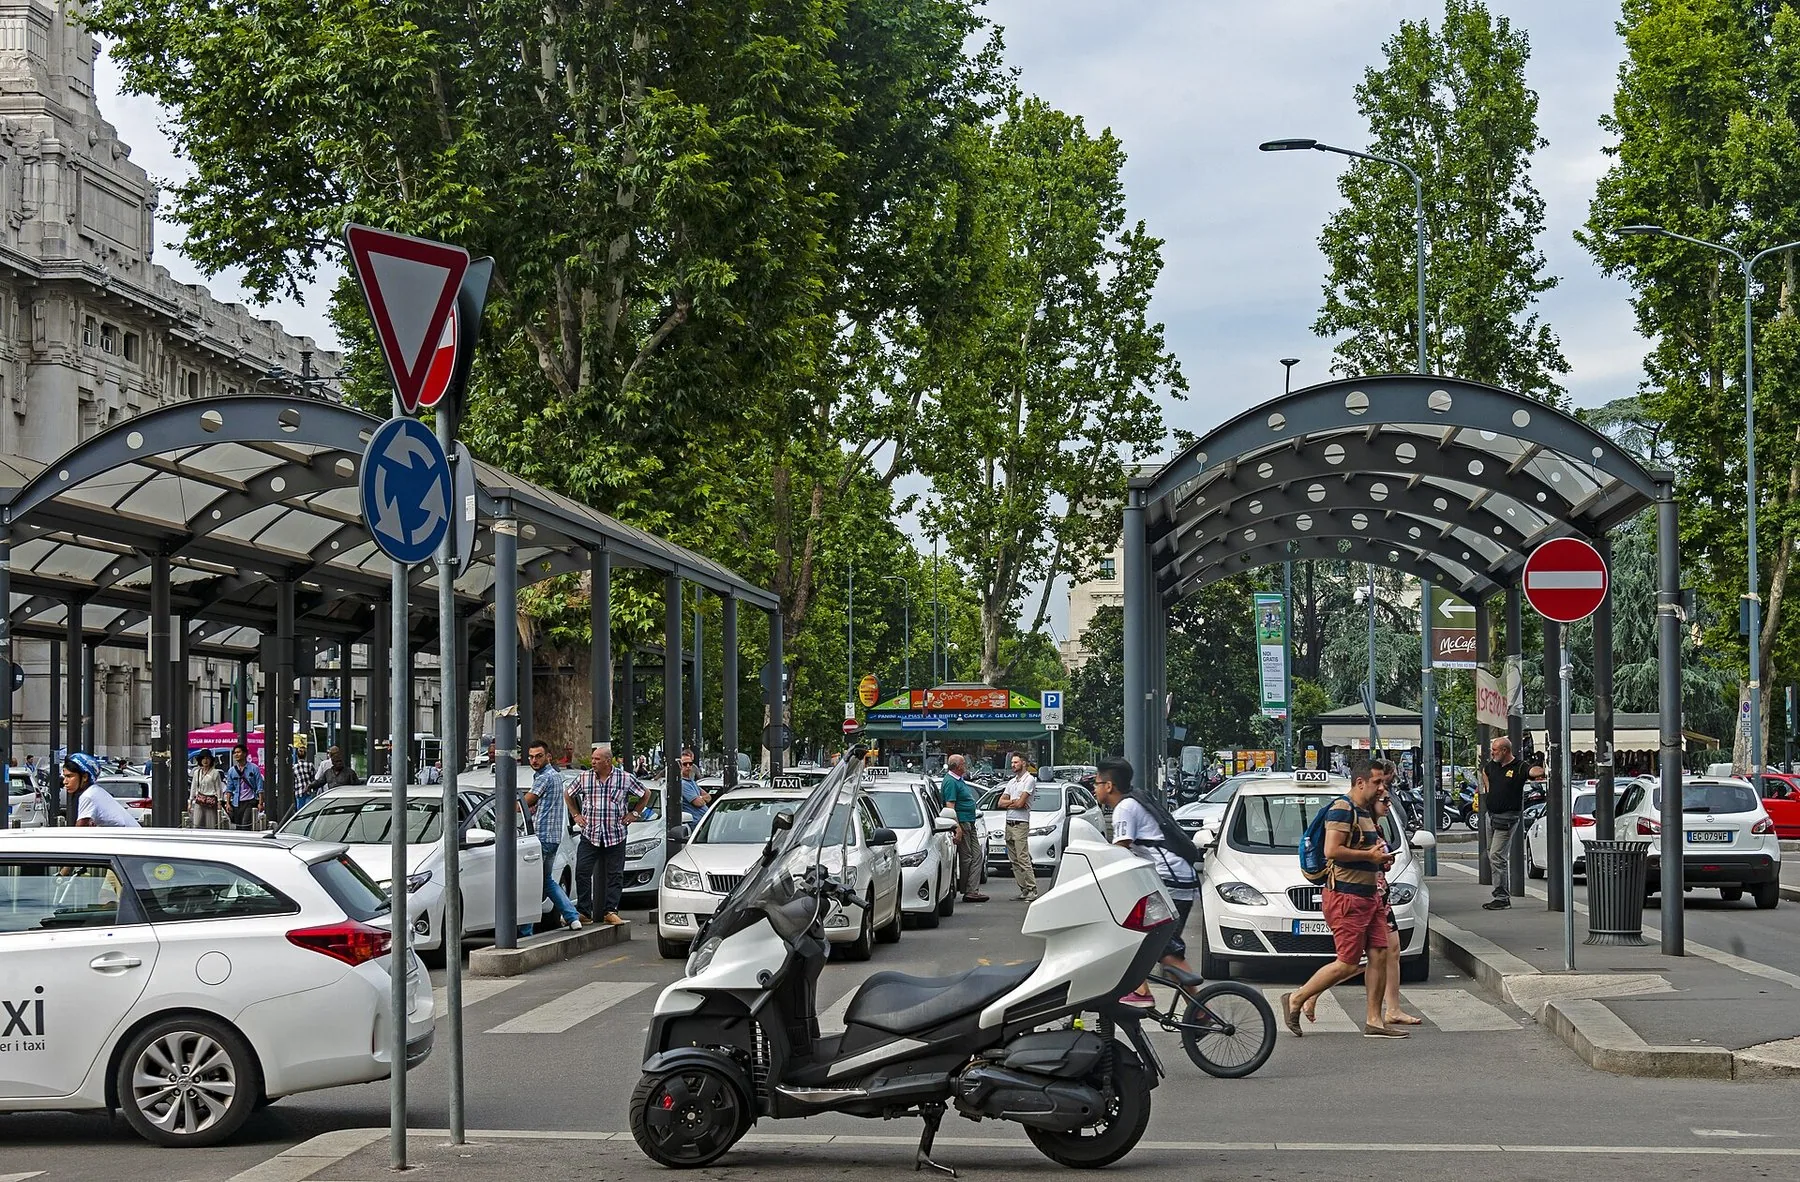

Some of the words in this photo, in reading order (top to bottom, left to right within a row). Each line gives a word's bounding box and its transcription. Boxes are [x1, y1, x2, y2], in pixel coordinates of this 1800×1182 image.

[1047, 695, 1056, 707] P
[1297, 772, 1325, 780] TAXI
[775, 780, 798, 788] TAXI
[1300, 923, 1310, 933] EH
[1311, 923, 1332, 933] 492S
[15, 1040, 19, 1051] i
[23, 1039, 45, 1051] taxi
